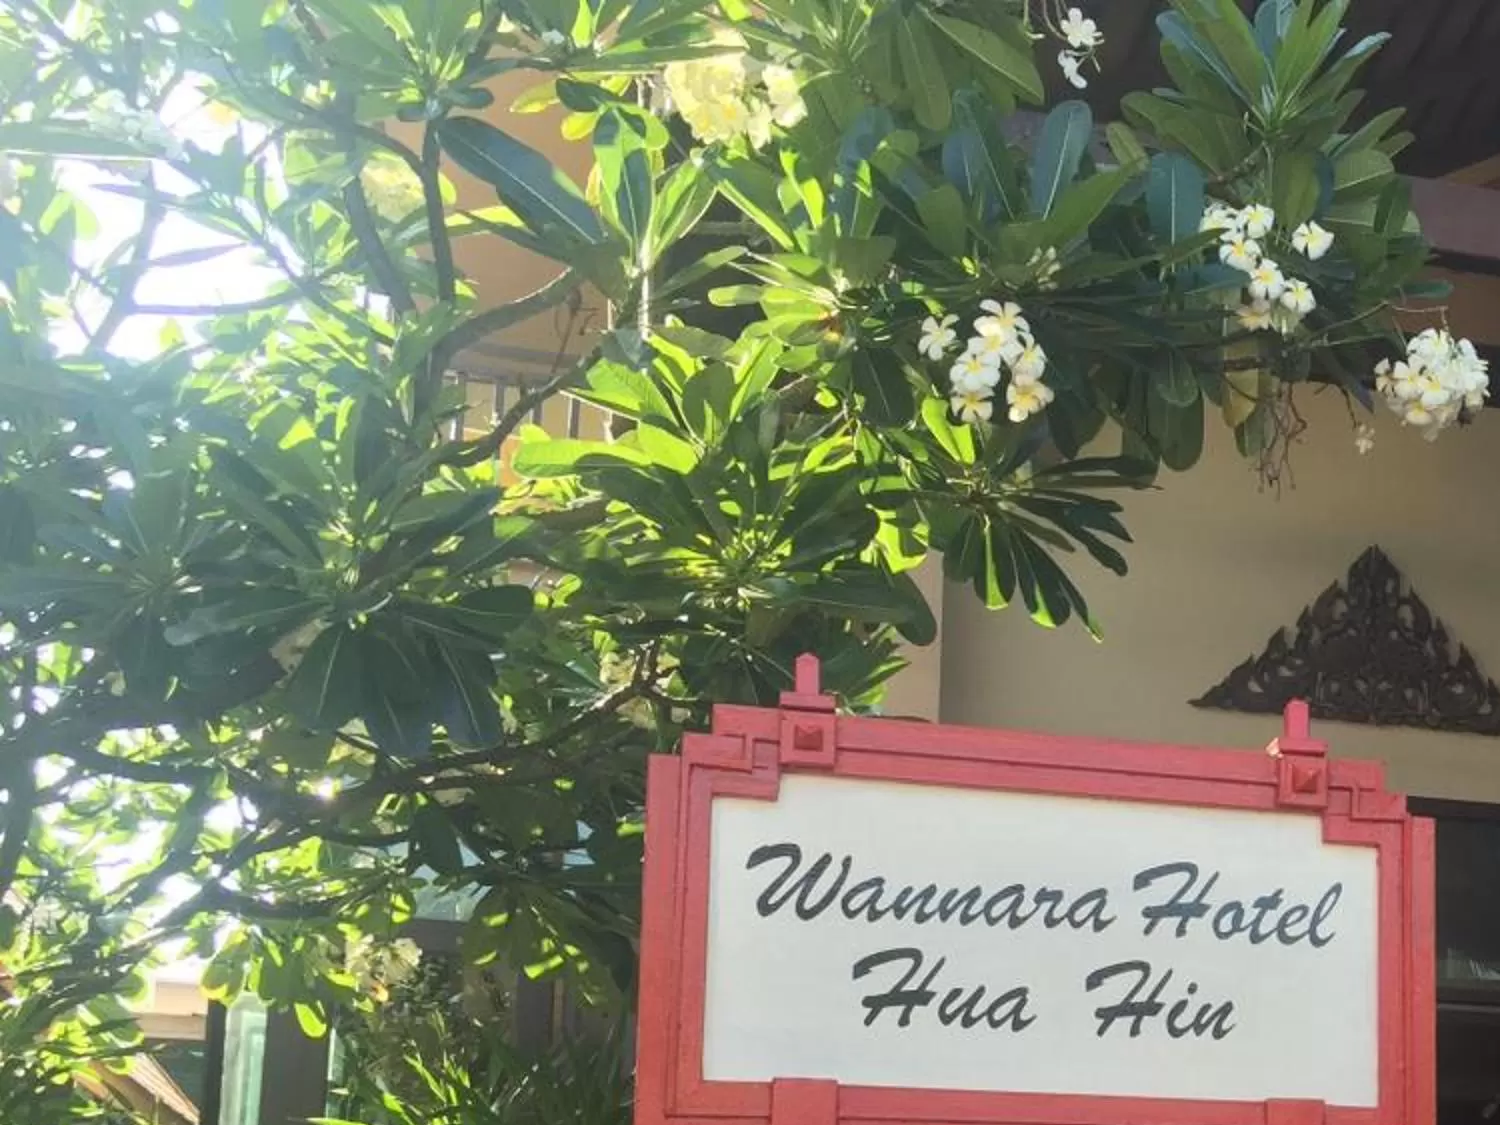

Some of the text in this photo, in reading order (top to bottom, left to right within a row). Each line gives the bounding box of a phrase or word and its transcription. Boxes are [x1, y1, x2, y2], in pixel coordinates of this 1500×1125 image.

[744, 842, 1344, 949] Wannara Hotel
[851, 946, 1237, 1042] Hua Hin
